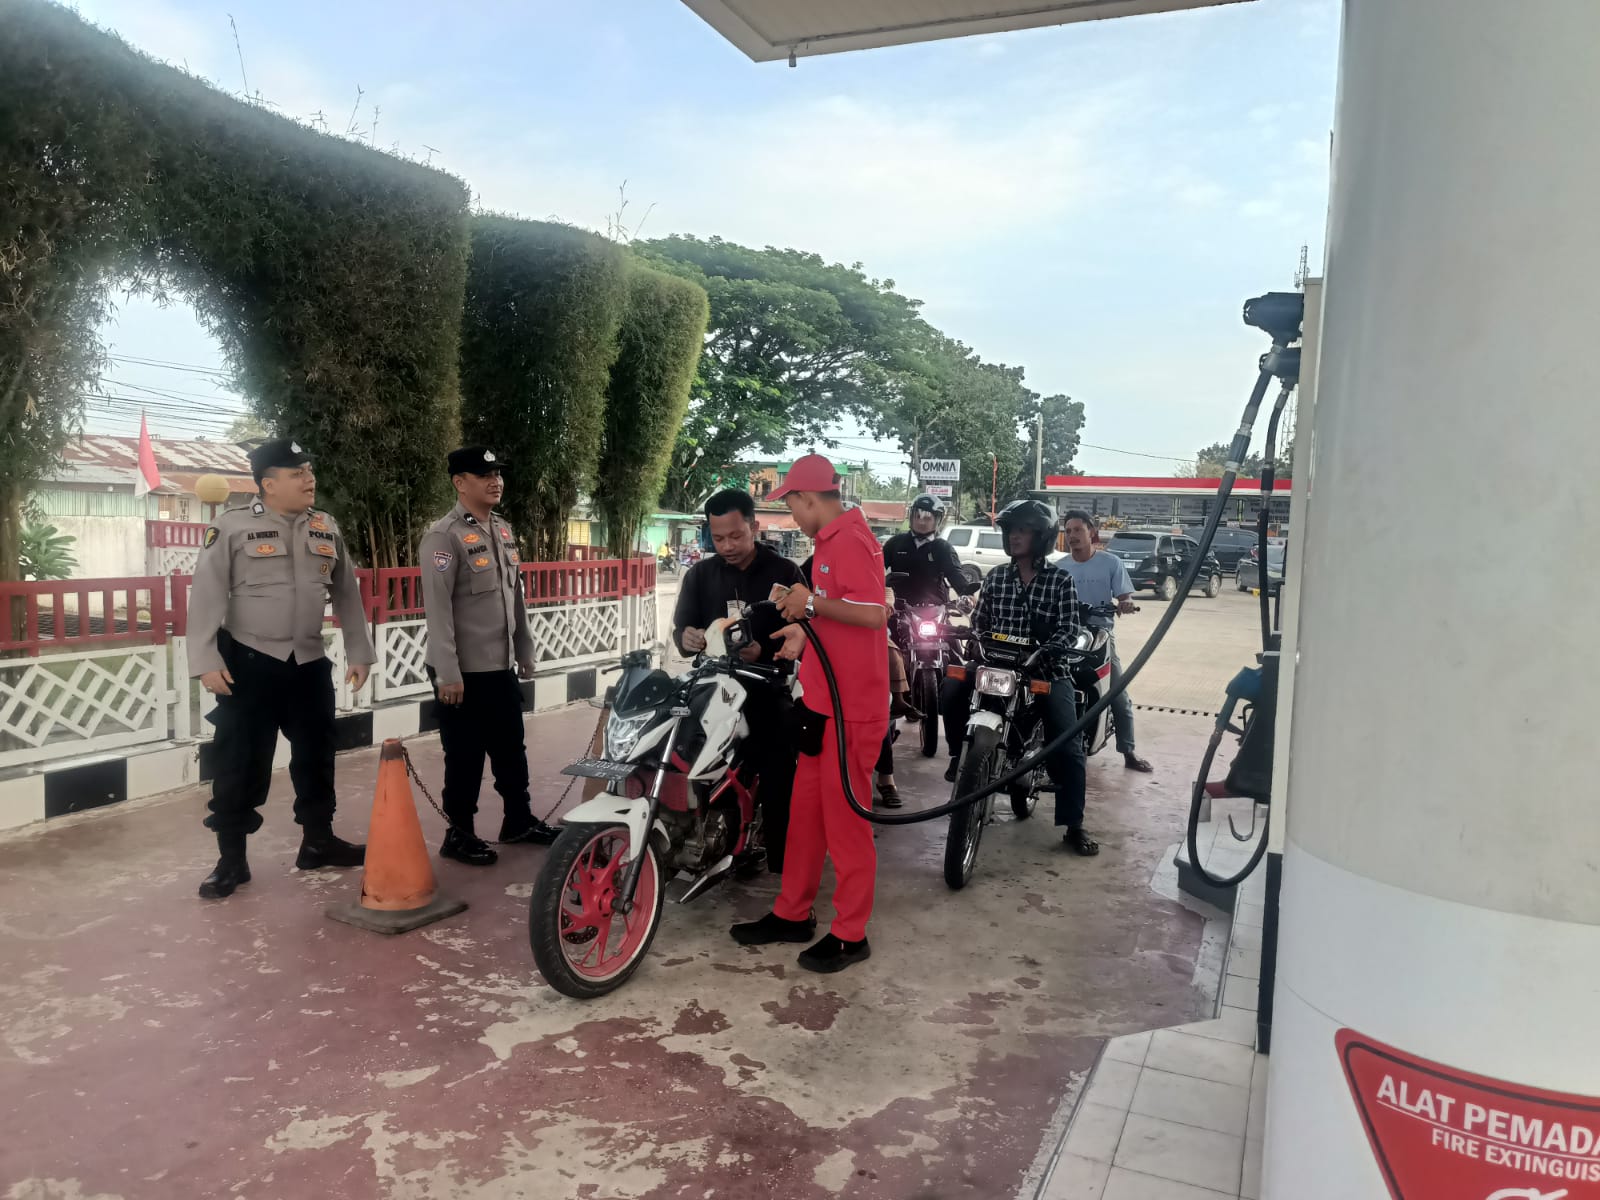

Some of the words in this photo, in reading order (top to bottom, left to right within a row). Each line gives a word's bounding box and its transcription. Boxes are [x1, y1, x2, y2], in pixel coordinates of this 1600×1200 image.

[309, 530, 333, 541] POLRI
[1376, 1074, 1456, 1123] ALAT
[1432, 1128, 1480, 1159] FIRE
